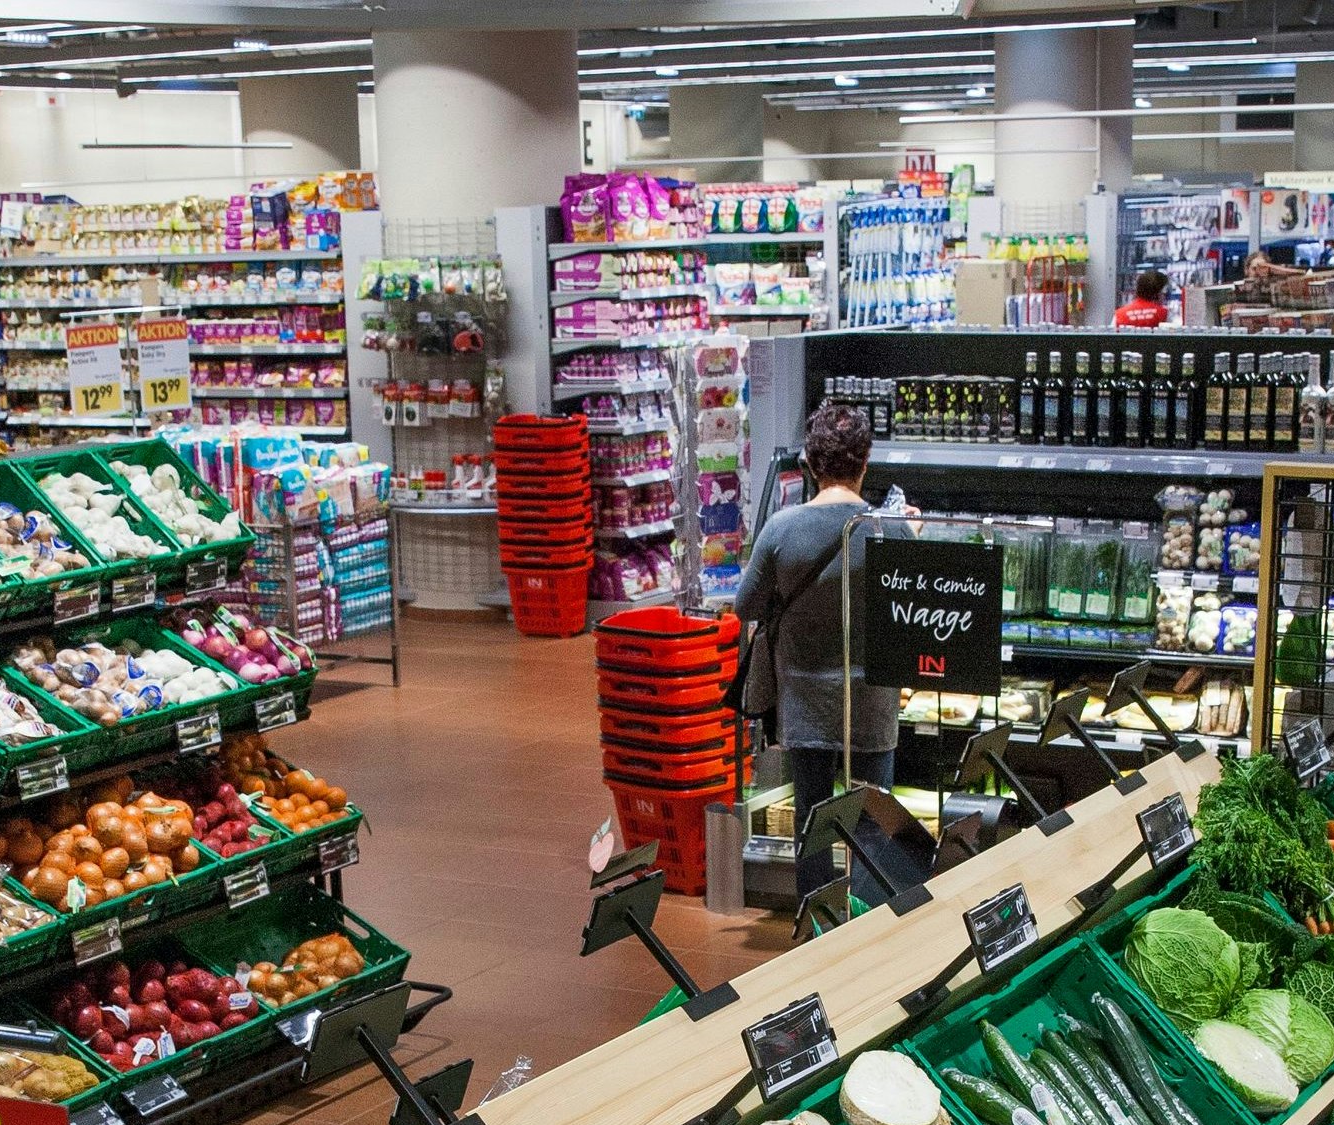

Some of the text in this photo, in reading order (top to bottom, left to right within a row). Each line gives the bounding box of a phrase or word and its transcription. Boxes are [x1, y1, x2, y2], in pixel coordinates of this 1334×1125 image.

[68, 325, 117, 346] AKTION
[138, 322, 187, 341] AKTION
[881, 568, 986, 596] Obst & Gemüse
[891, 600, 973, 641] Waage
